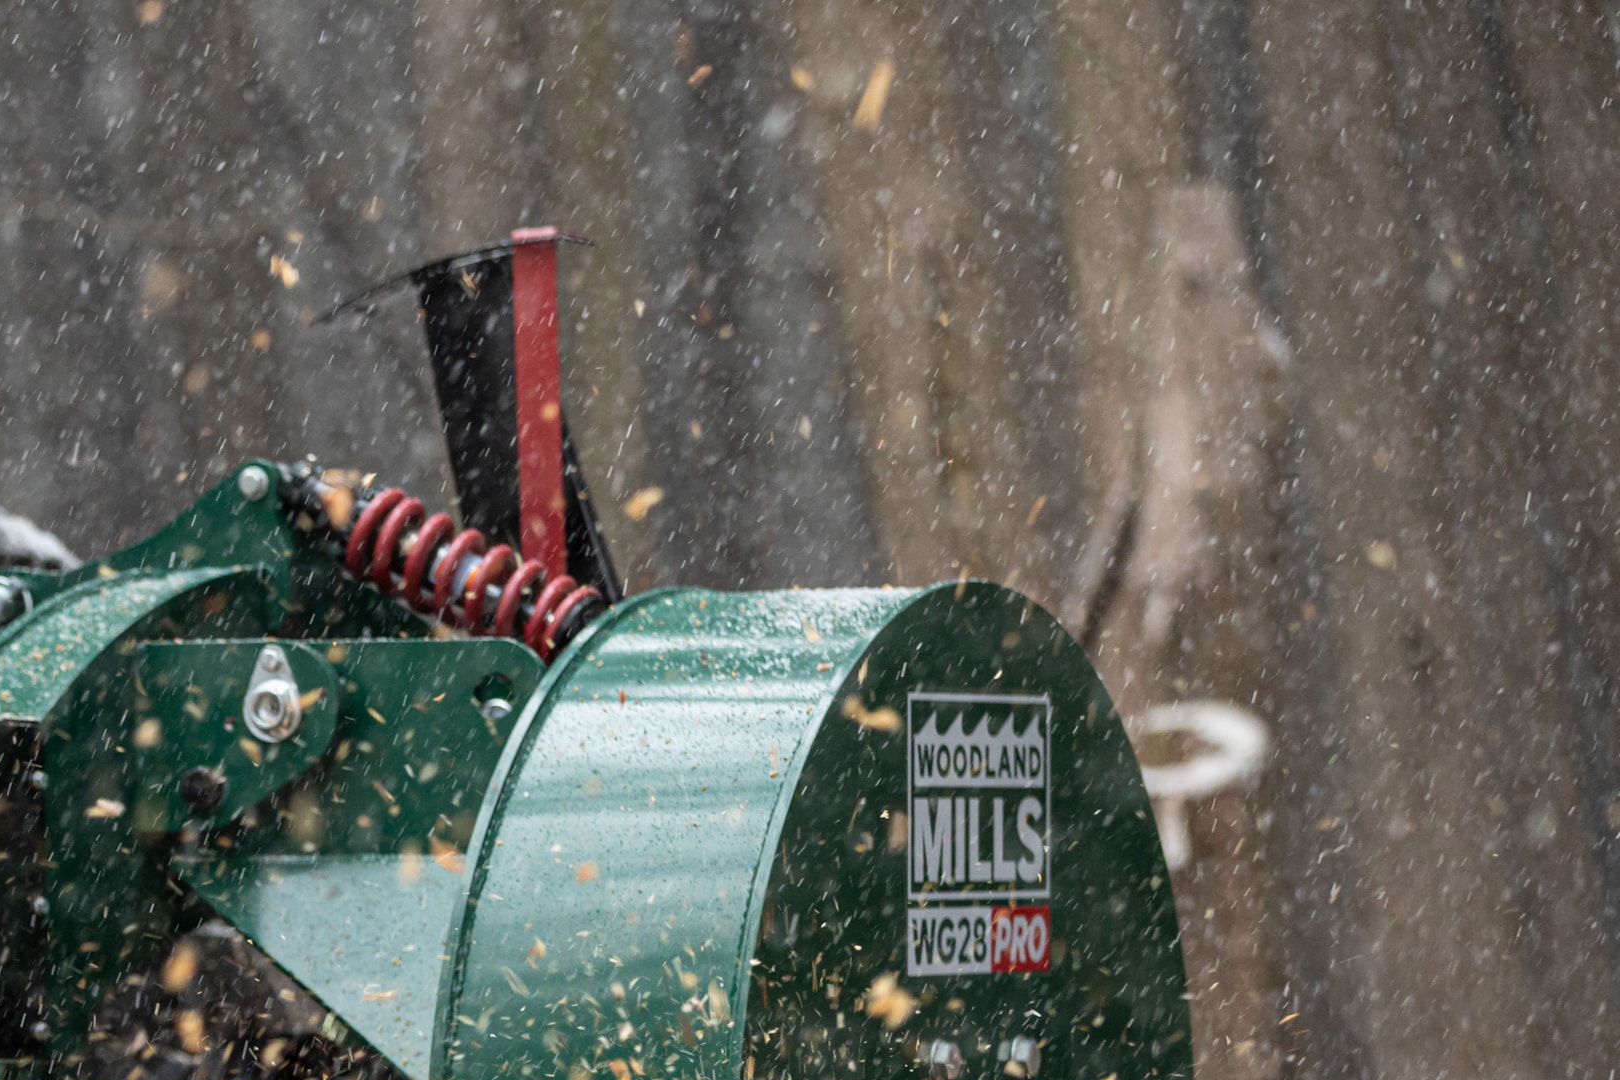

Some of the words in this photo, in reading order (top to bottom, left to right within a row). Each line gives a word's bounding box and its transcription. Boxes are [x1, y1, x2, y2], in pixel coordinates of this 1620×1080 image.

[917, 744, 1042, 778] WOODLAND
[913, 796, 1044, 883] MILLS
[912, 915, 987, 966] WG28
[993, 912, 1048, 965] PRO
